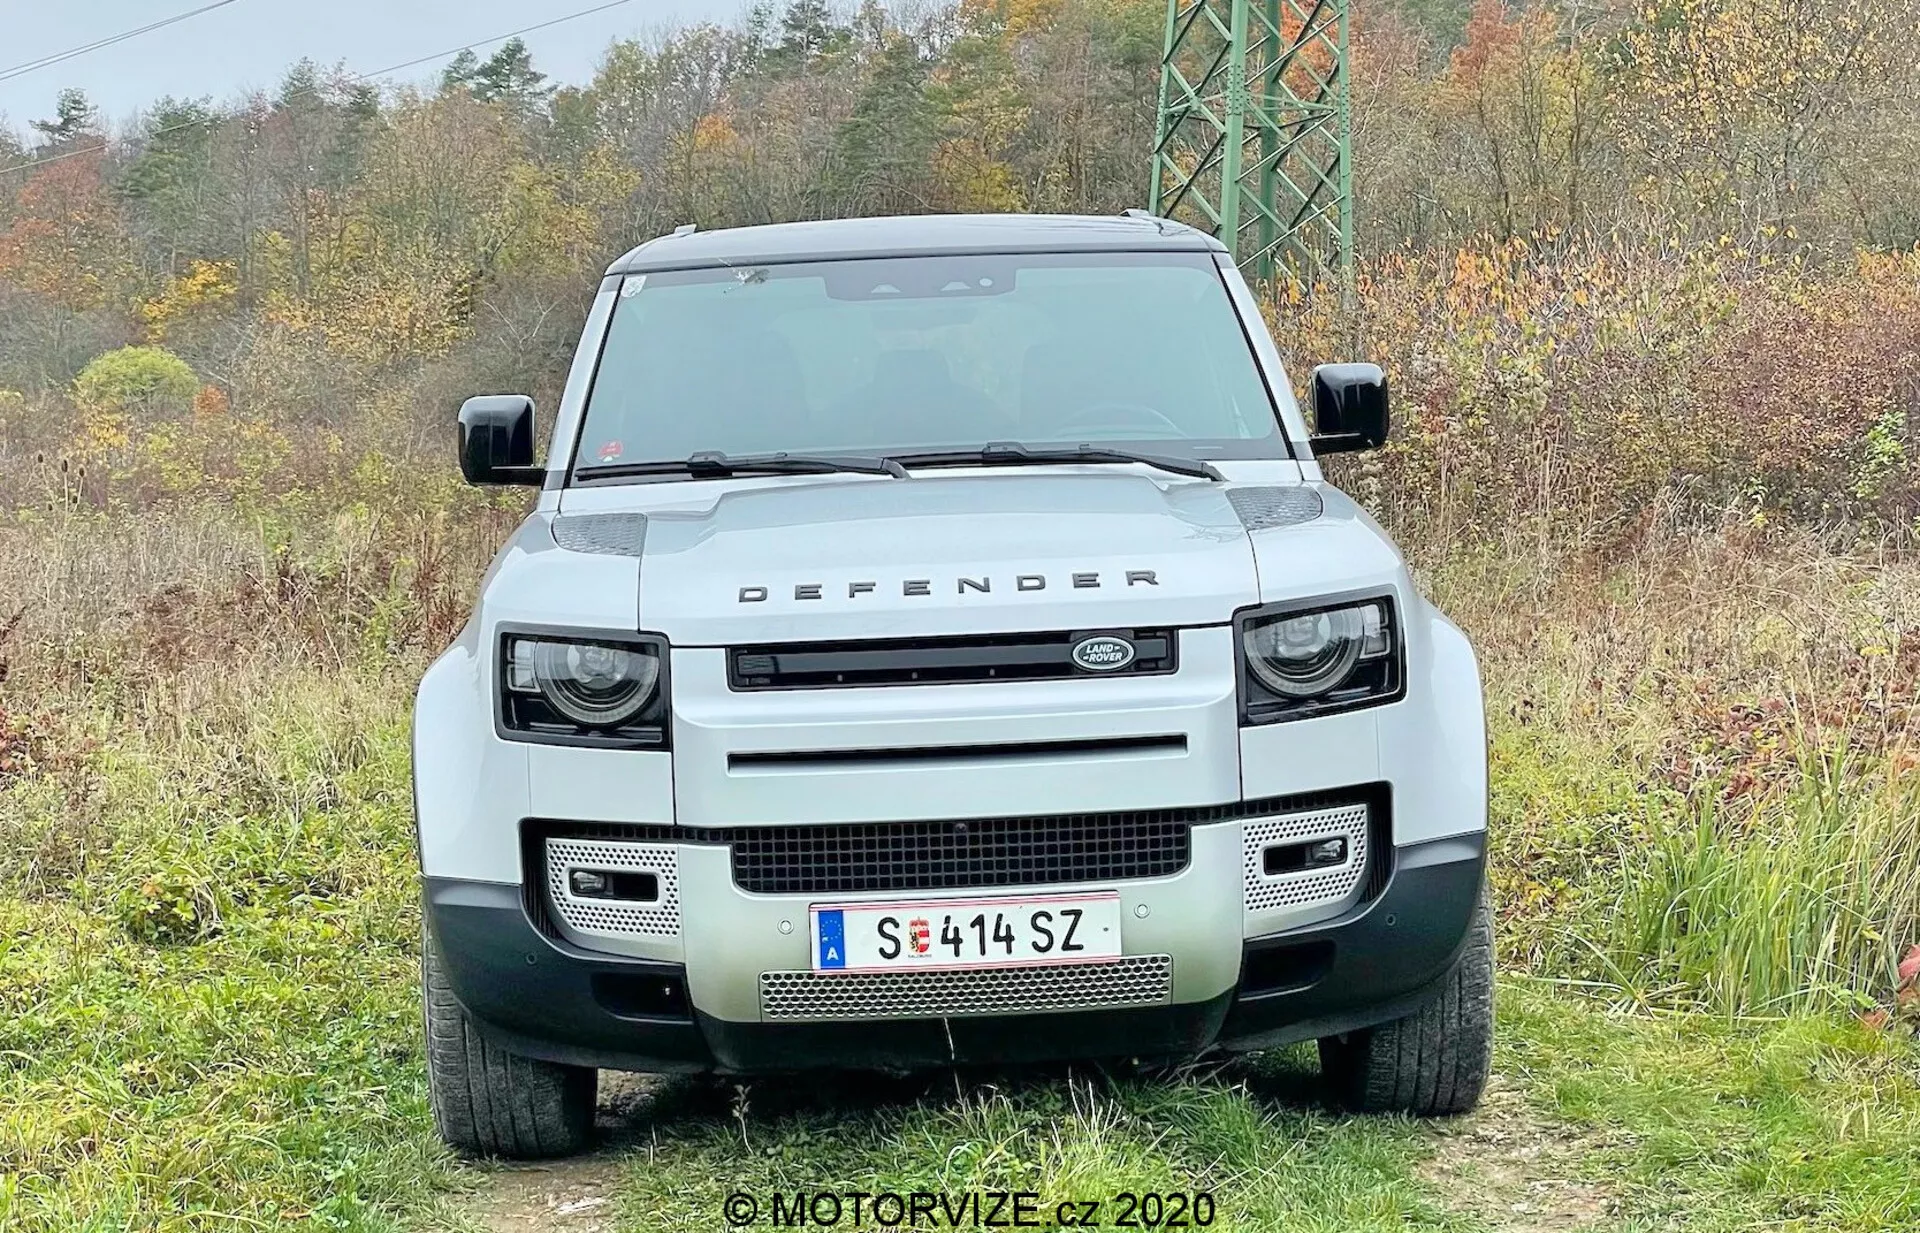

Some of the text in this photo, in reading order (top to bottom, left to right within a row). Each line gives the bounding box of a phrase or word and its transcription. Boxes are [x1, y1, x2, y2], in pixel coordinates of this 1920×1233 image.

[738, 569, 1160, 603] DEFENDER
[877, 908, 1084, 960] S 414 SZ
[826, 947, 840, 961] A
